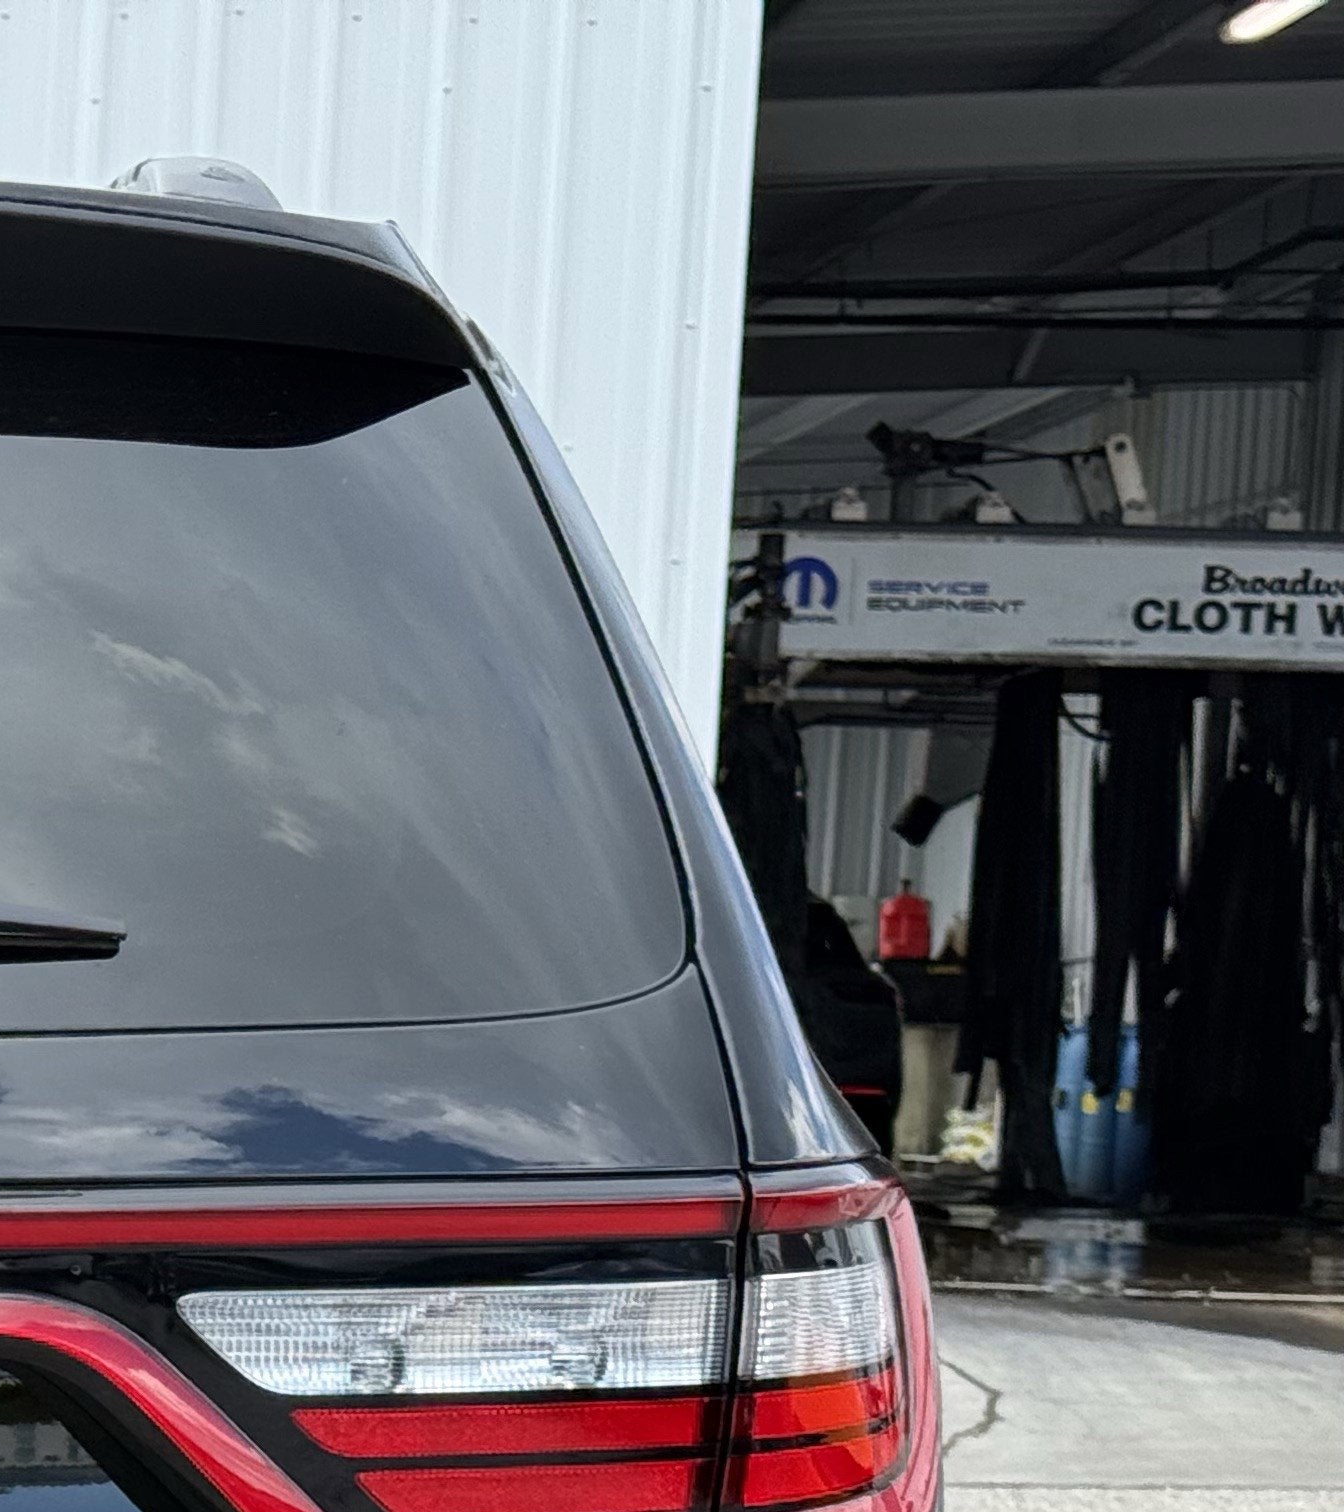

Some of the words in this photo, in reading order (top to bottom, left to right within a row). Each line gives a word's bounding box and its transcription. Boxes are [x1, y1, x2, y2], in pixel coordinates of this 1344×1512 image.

[866, 579, 992, 597] SERVICE
[866, 597, 1027, 614] EQUIPMENT
[1133, 599, 1298, 636] CLOTH
